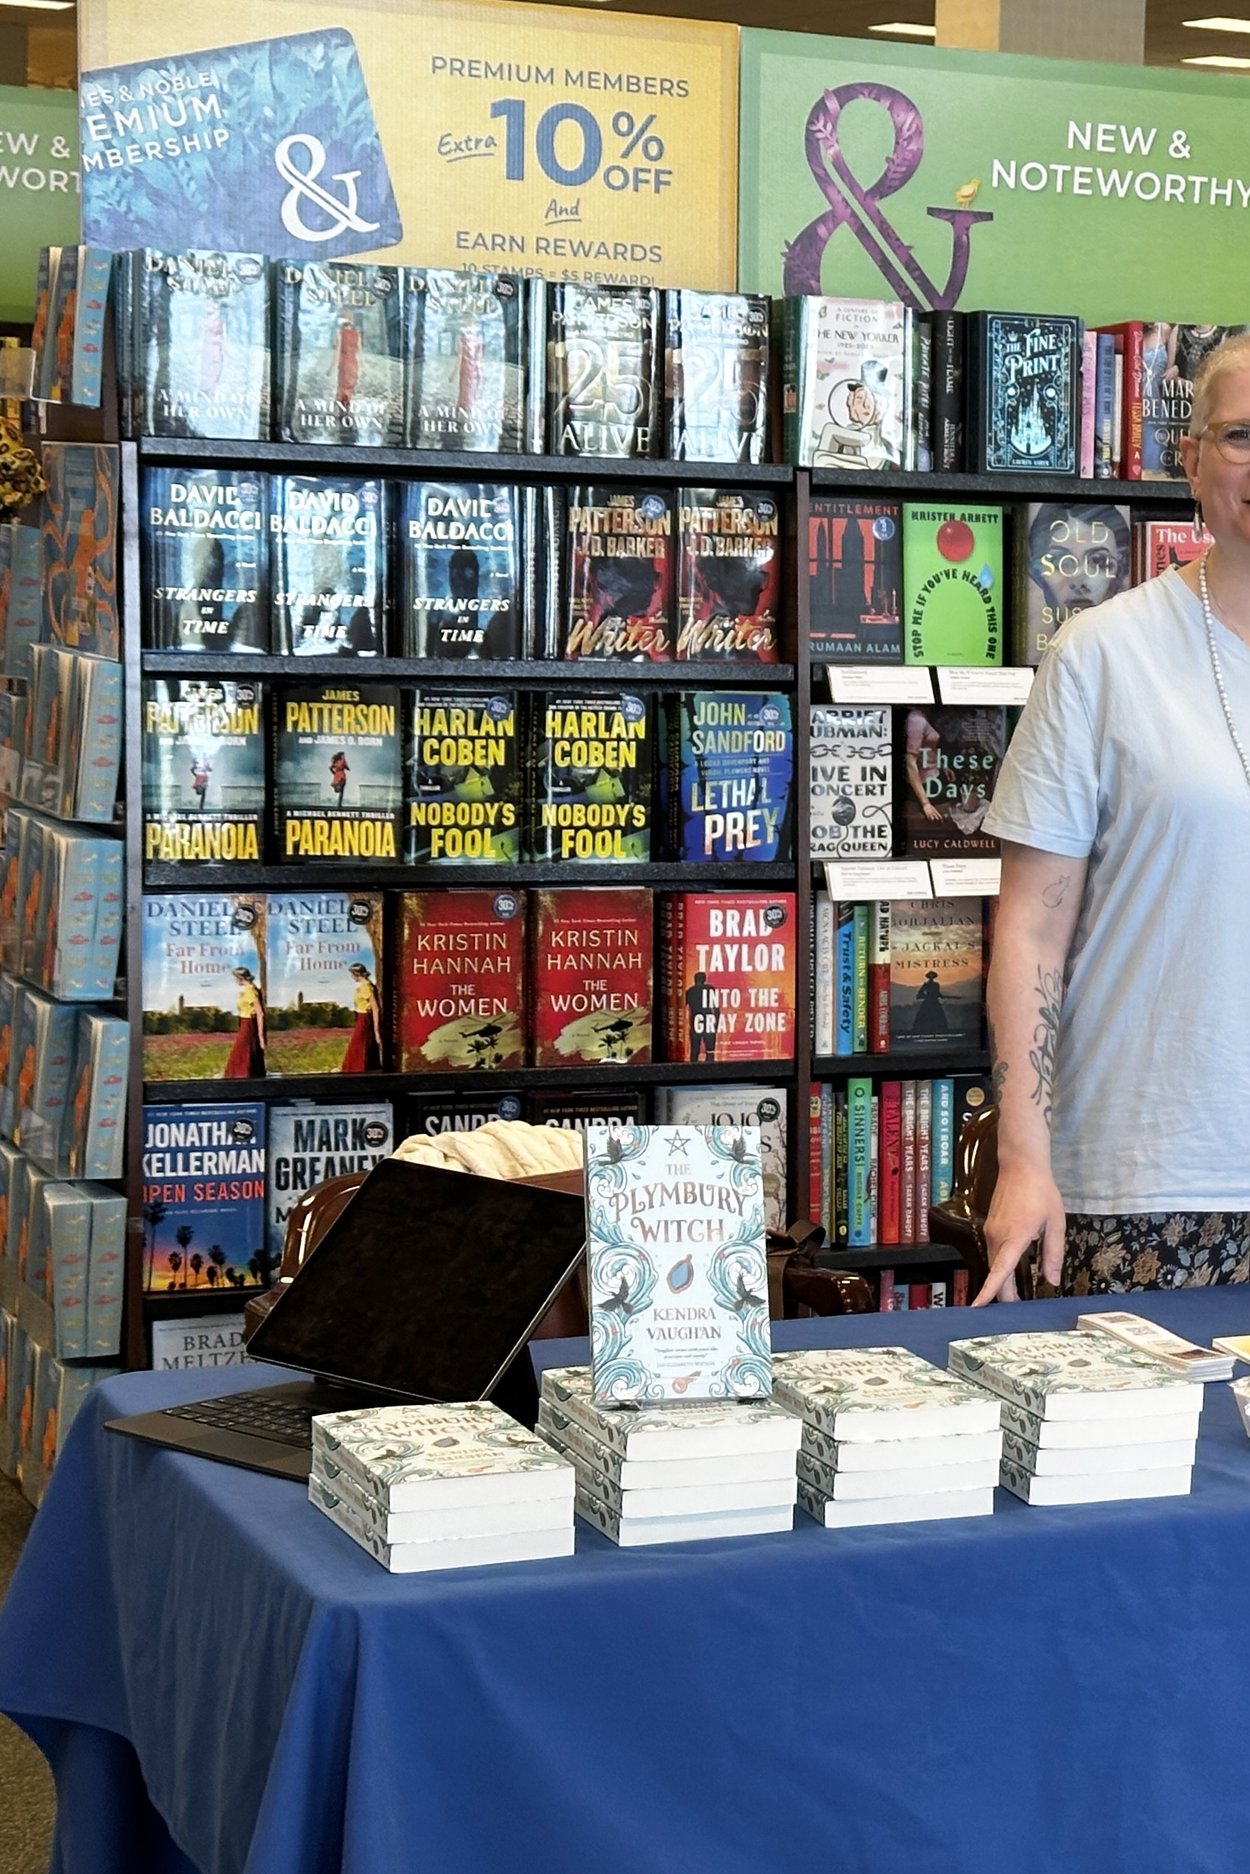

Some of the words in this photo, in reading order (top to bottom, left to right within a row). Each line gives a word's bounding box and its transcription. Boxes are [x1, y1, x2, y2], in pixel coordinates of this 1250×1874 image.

[431, 56, 554, 86] PREMIUM
[564, 69, 689, 98] MEMBERS
[437, 133, 497, 153] Extra
[1068, 120, 1157, 156] NEW
[1168, 130, 1191, 159] &
[603, 165, 673, 194] OFF
[545, 198, 580, 217] And
[455, 231, 525, 253] EARN
[535, 237, 662, 264] REWARDS
[482, 264, 543, 279] STAMPS
[836, 312, 879, 324] FICTION
[150, 508, 261, 531] BALDACCI
[1049, 520, 1109, 545] OLD
[1040, 553, 1117, 579] SOUL
[183, 620, 229, 635] TIME
[322, 689, 359, 701] JAMES
[286, 702, 395, 736] PATTERSON
[415, 708, 514, 737] HARLAN
[545, 709, 646, 739] HARLAN
[694, 701, 746, 726] JOHN
[423, 738, 505, 767] COBEN
[554, 740, 636, 768] COBEN
[692, 730, 786, 755] SANDFORD
[920, 748, 993, 770] These
[926, 776, 986, 806] Days
[411, 801, 516, 827] NOBODY'S
[541, 803, 646, 827] NOBODY'S
[146, 822, 259, 860] PARANOIA
[286, 820, 396, 858] PARANOIA
[431, 828, 496, 858] FOOL
[704, 808, 779, 855] PREY
[561, 829, 626, 859] FOOL
[840, 842, 888, 852] QUEEN
[914, 840, 940, 848] LUCY
[944, 839, 996, 849] CALDWELL
[417, 933, 506, 951] KRISTIN
[551, 930, 638, 947] KRISTIN
[413, 957, 511, 975] HANNAH
[547, 953, 642, 970] HANNAH
[696, 944, 785, 973] TAYLOR
[450, 984, 476, 996] THE
[583, 980, 607, 991] THE
[702, 988, 741, 1008] INTO
[750, 987, 779, 1008] THE
[417, 998, 508, 1017] WOMEN
[550, 993, 638, 1013] WOMEN
[694, 1015, 737, 1034] GRAY
[745, 1013, 786, 1032] ZONE
[665, 1163, 691, 1175] THE
[609, 1182, 746, 1222] PLYMBURY
[631, 1217, 725, 1243] WITCH
[653, 1307, 717, 1321] KENDRA
[647, 1326, 722, 1340] VAUGHAN
